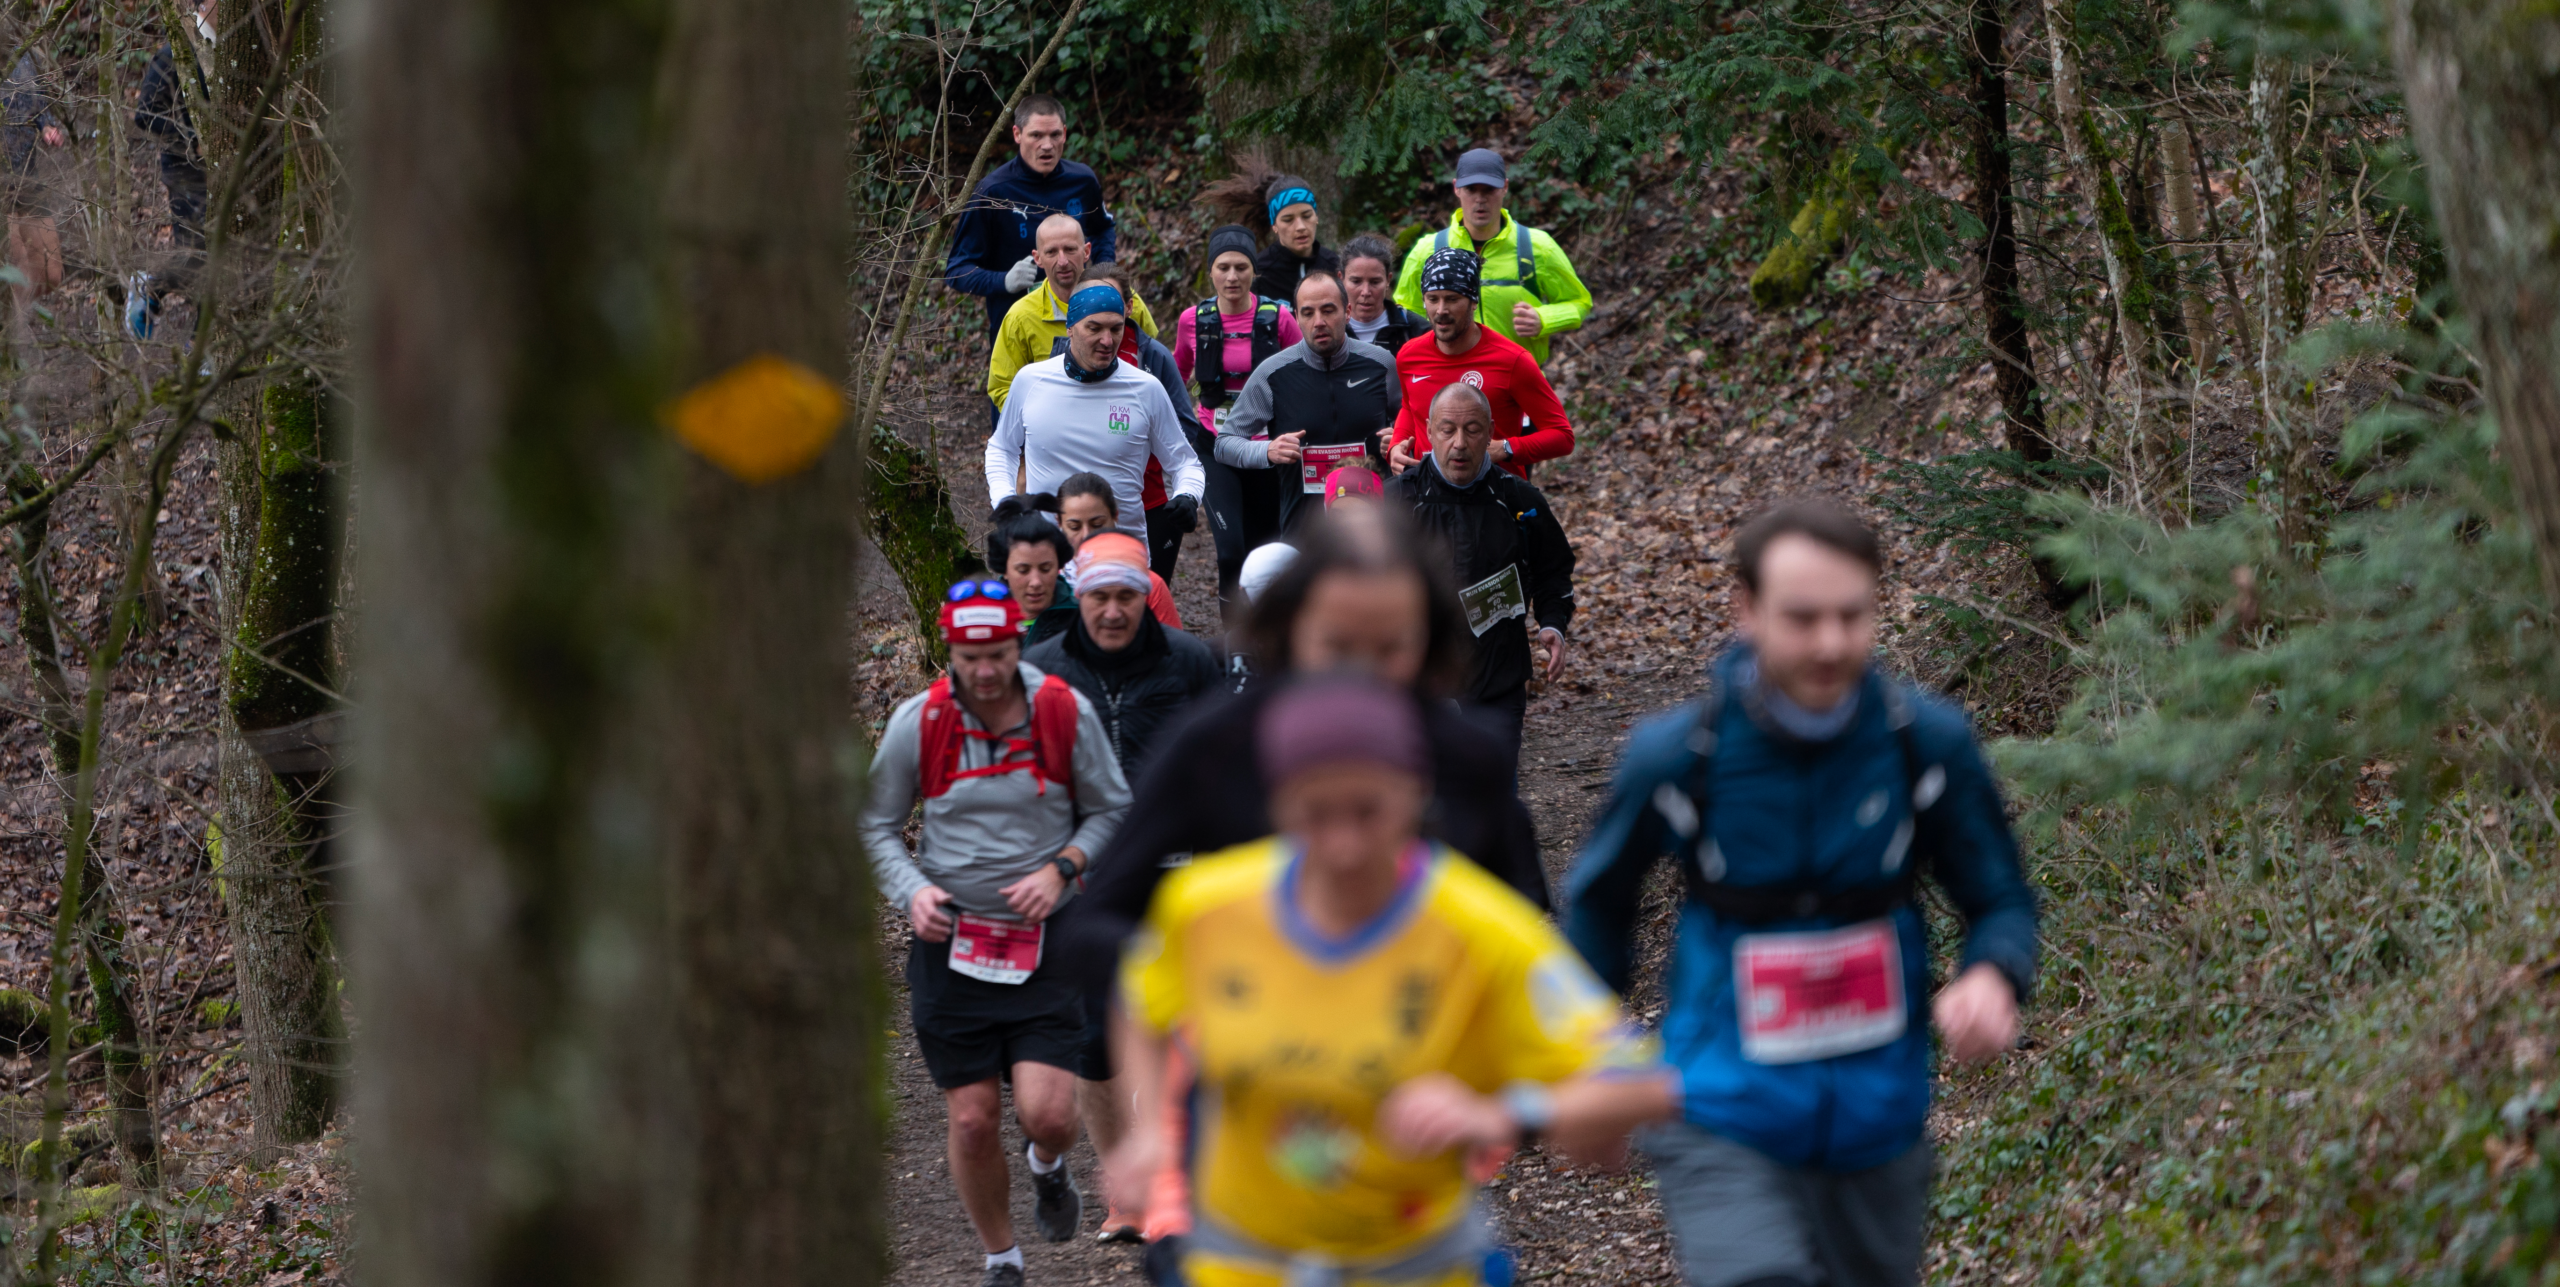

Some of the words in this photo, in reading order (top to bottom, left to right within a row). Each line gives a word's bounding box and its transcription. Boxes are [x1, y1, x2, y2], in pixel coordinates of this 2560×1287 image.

[1019, 222, 1028, 239] 5
[1109, 404, 1117, 413] 10
[1118, 405, 1130, 414] KM
[1318, 447, 1341, 455] EVASION
[1465, 588, 1478, 598] RUN
[1477, 576, 1500, 592] EVASION
